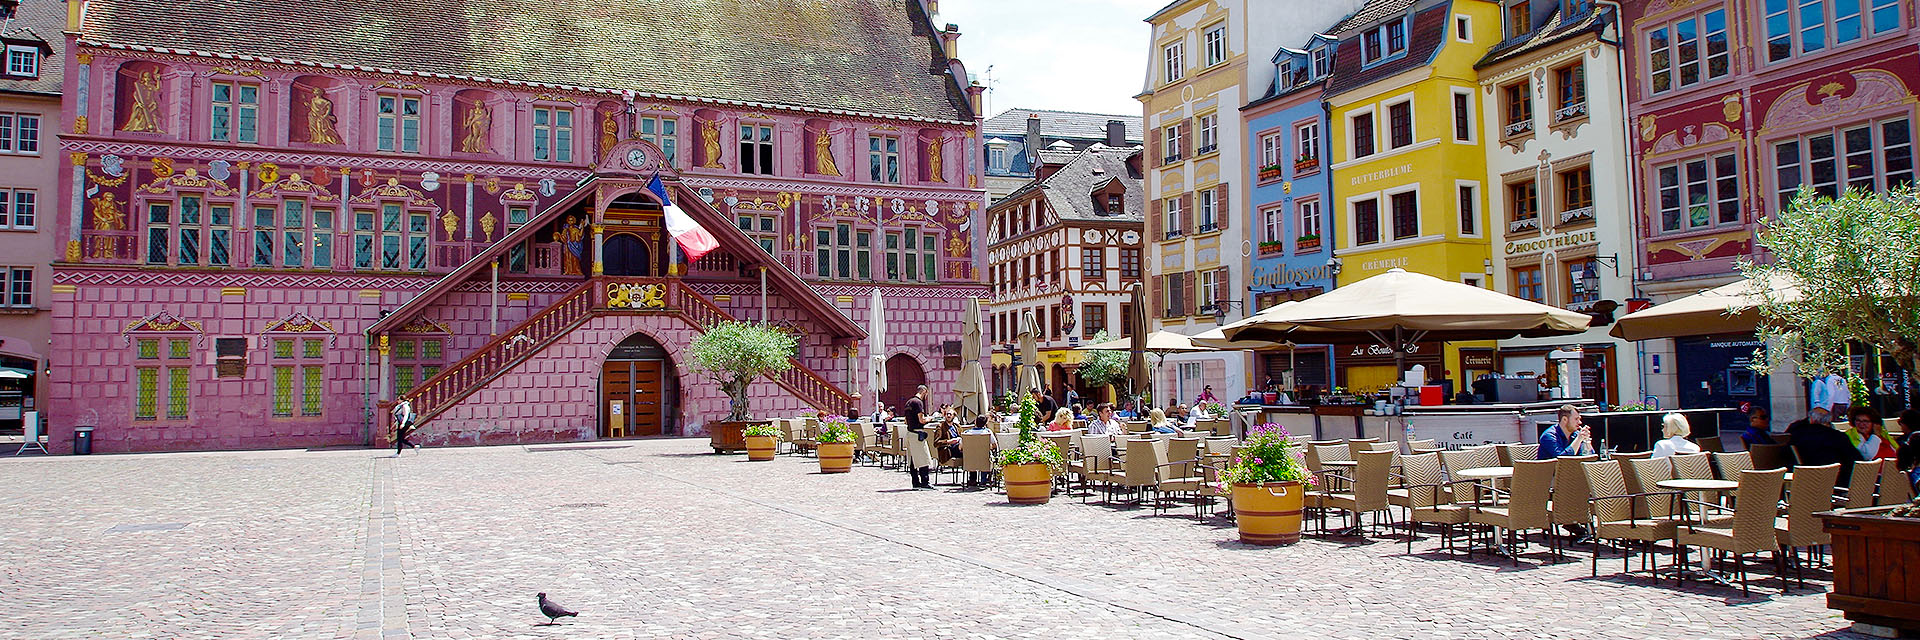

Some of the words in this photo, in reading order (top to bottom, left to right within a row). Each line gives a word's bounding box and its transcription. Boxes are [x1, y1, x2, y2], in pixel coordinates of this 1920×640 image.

[1351, 163, 1413, 186] BUTTERBLUME
[1250, 263, 1332, 287] Guillosson
[1351, 345, 1364, 356] Au
[1453, 431, 1473, 440] Café
